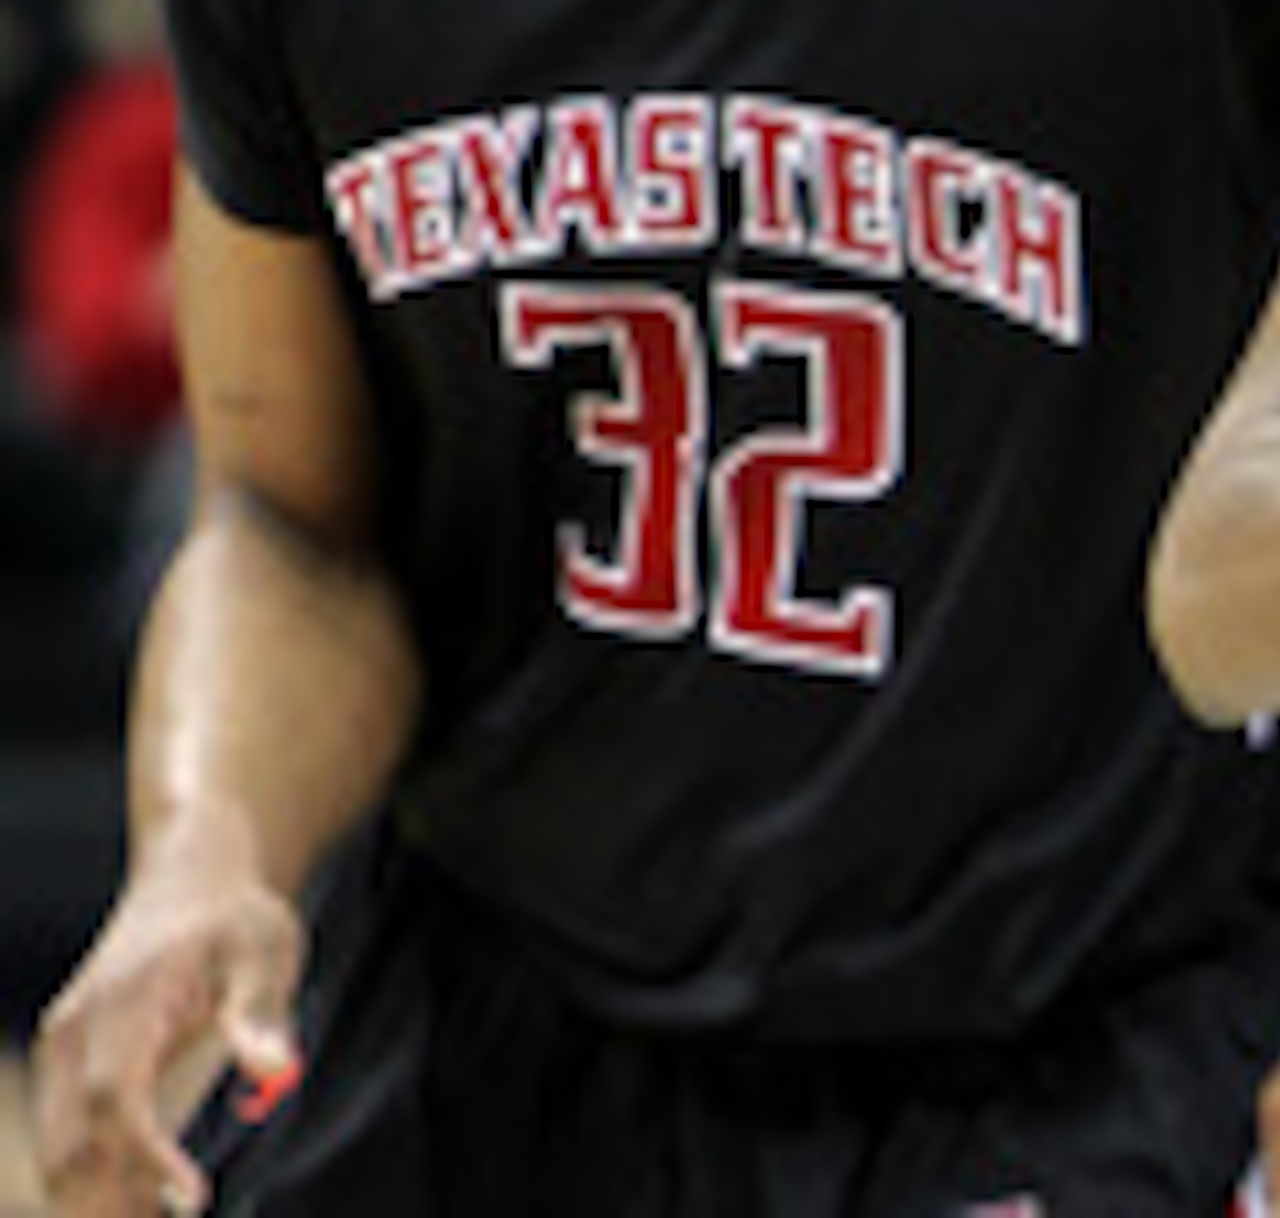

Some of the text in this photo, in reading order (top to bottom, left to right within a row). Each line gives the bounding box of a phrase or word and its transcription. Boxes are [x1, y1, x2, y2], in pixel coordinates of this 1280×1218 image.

[324, 92, 1085, 346] TEXAS TECH
[500, 282, 905, 678] 32
